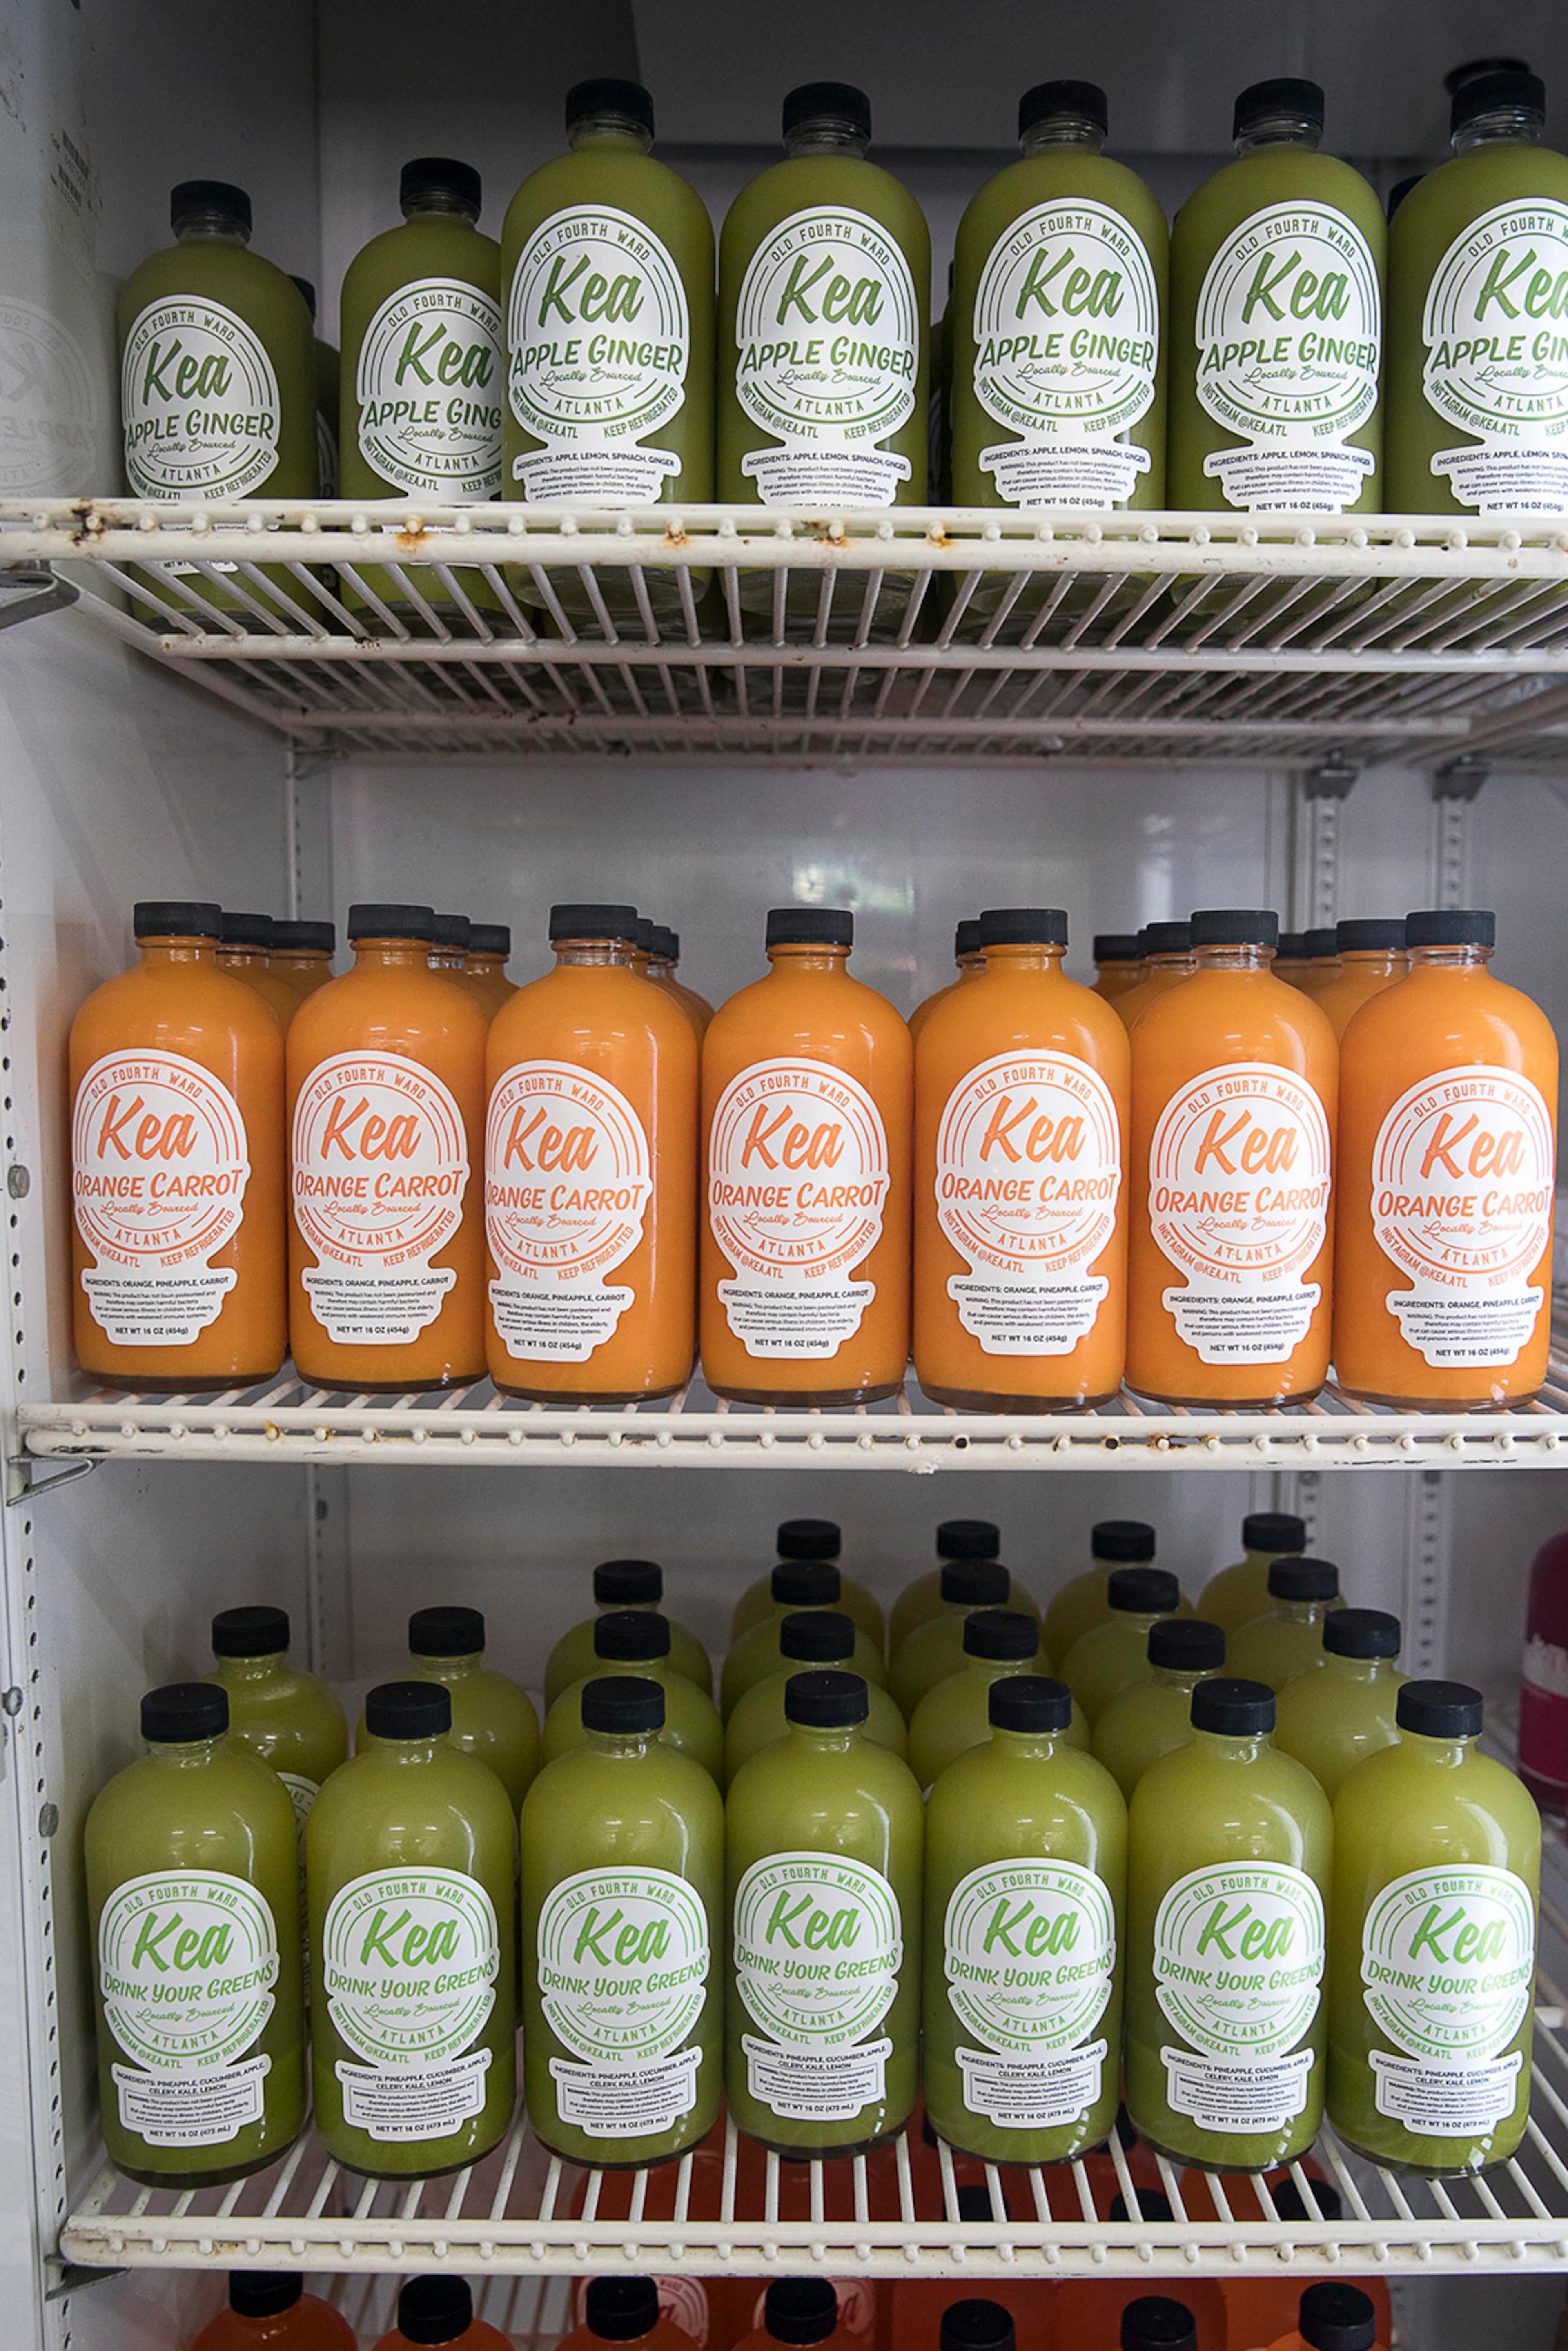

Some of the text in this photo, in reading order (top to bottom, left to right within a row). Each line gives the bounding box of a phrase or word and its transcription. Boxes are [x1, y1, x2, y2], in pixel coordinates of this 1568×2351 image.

[534, 223, 650, 265] OLD FOURTH WARD
[1011, 216, 1129, 256] OLD FOURTH WARD
[539, 254, 644, 327] Kea
[776, 254, 884, 326] Kea
[1016, 247, 1124, 320] Kea
[1241, 250, 1350, 324] Kea
[395, 321, 494, 389] Kea
[511, 334, 682, 380] APPLE GINGER
[742, 336, 914, 381] APPLE GINGER
[980, 329, 1154, 372] APPLE GINGER
[1203, 332, 1377, 376] APPLE GINGER
[1430, 335, 1526, 373] APPLE
[142, 339, 232, 406] Kea
[363, 397, 501, 432] APPLE GING
[555, 396, 624, 414] ATLANTA
[603, 387, 678, 438] KEEP REFRIGERATED
[794, 398, 864, 415] ATLANTA
[1203, 382, 1240, 423] INSTAGRAM
[1261, 395, 1332, 412] ATLANTA
[127, 409, 274, 452] APPLE GINGER
[1125, 452, 1145, 463] GINGER
[736, 1075, 850, 1108] OLD FOURTH WARD
[1188, 1080, 1303, 1113] OLD FOURTH WARD
[98, 1093, 197, 1160] Kea
[321, 1095, 421, 1161] Kea
[503, 1105, 599, 1173] Kea
[742, 1102, 845, 1170] Kea
[980, 1095, 1086, 1163] Kea
[1195, 1106, 1300, 1175] Kea
[1420, 1109, 1526, 1179] Kea
[76, 1169, 241, 1198] ORANGE CARROT
[294, 1170, 462, 1198] ORANGE CARROT
[550, 1184, 642, 1211] CARROT
[712, 1180, 883, 1209] ORANGE CARROT
[942, 1173, 1117, 1201] ORANGE CARROT
[1156, 1182, 1328, 1213] ORANGE CARROT
[1379, 1185, 1552, 1217] ORANGE CARROT
[339, 1228, 403, 1245] ATLANTA
[383, 1211, 454, 1266] KEEP REFRIGERATED
[759, 1239, 825, 1256] ATLANTA
[998, 1233, 1067, 1251] ATLANTA
[1158, 1223, 1196, 1265] INSTAGRAM
[1215, 1243, 1281, 1261] ATLANTA
[841, 1289, 868, 1298] CARROT
[353, 1882, 463, 1910] OLD FOURTH WARD
[760, 1868, 866, 1893] OLD FOURTH WARD
[360, 1908, 460, 1968] Kea
[574, 1907, 671, 1966] Kea
[766, 1890, 861, 1951] Kea
[983, 1898, 1080, 1957] Kea
[1196, 1901, 1294, 1961] Kea
[1408, 1904, 1506, 1964] Kea
[132, 1912, 234, 1972] Kea
[103, 1960, 276, 2004] DRINK YOUR GREENS
[329, 1955, 497, 1999] DRINK YOUR GREENS
[543, 1955, 706, 1997] DRINK YOUR GREENS
[737, 1945, 899, 1982] DRINK YOUR GREENS
[949, 1948, 1114, 1988] DRINK YOUR GREENS
[1159, 1956, 1323, 1992] DRINK YOUR GREENS
[1368, 1960, 1424, 1992] DRINK
[1428, 1975, 1477, 1995] YOUR
[594, 2024, 657, 2042] ATLANTA
[783, 2008, 844, 2026] ATLANTA
[825, 1986, 892, 2044] KEEP REFRIGERATED
[953, 1993, 988, 2035] INSTAGRAM
[1002, 2016, 1065, 2033] ATLANTA
[152, 2031, 218, 2050] ATLANTA
[380, 2026, 444, 2044] ATLANTA
[426, 2077, 452, 2088] LEMON
